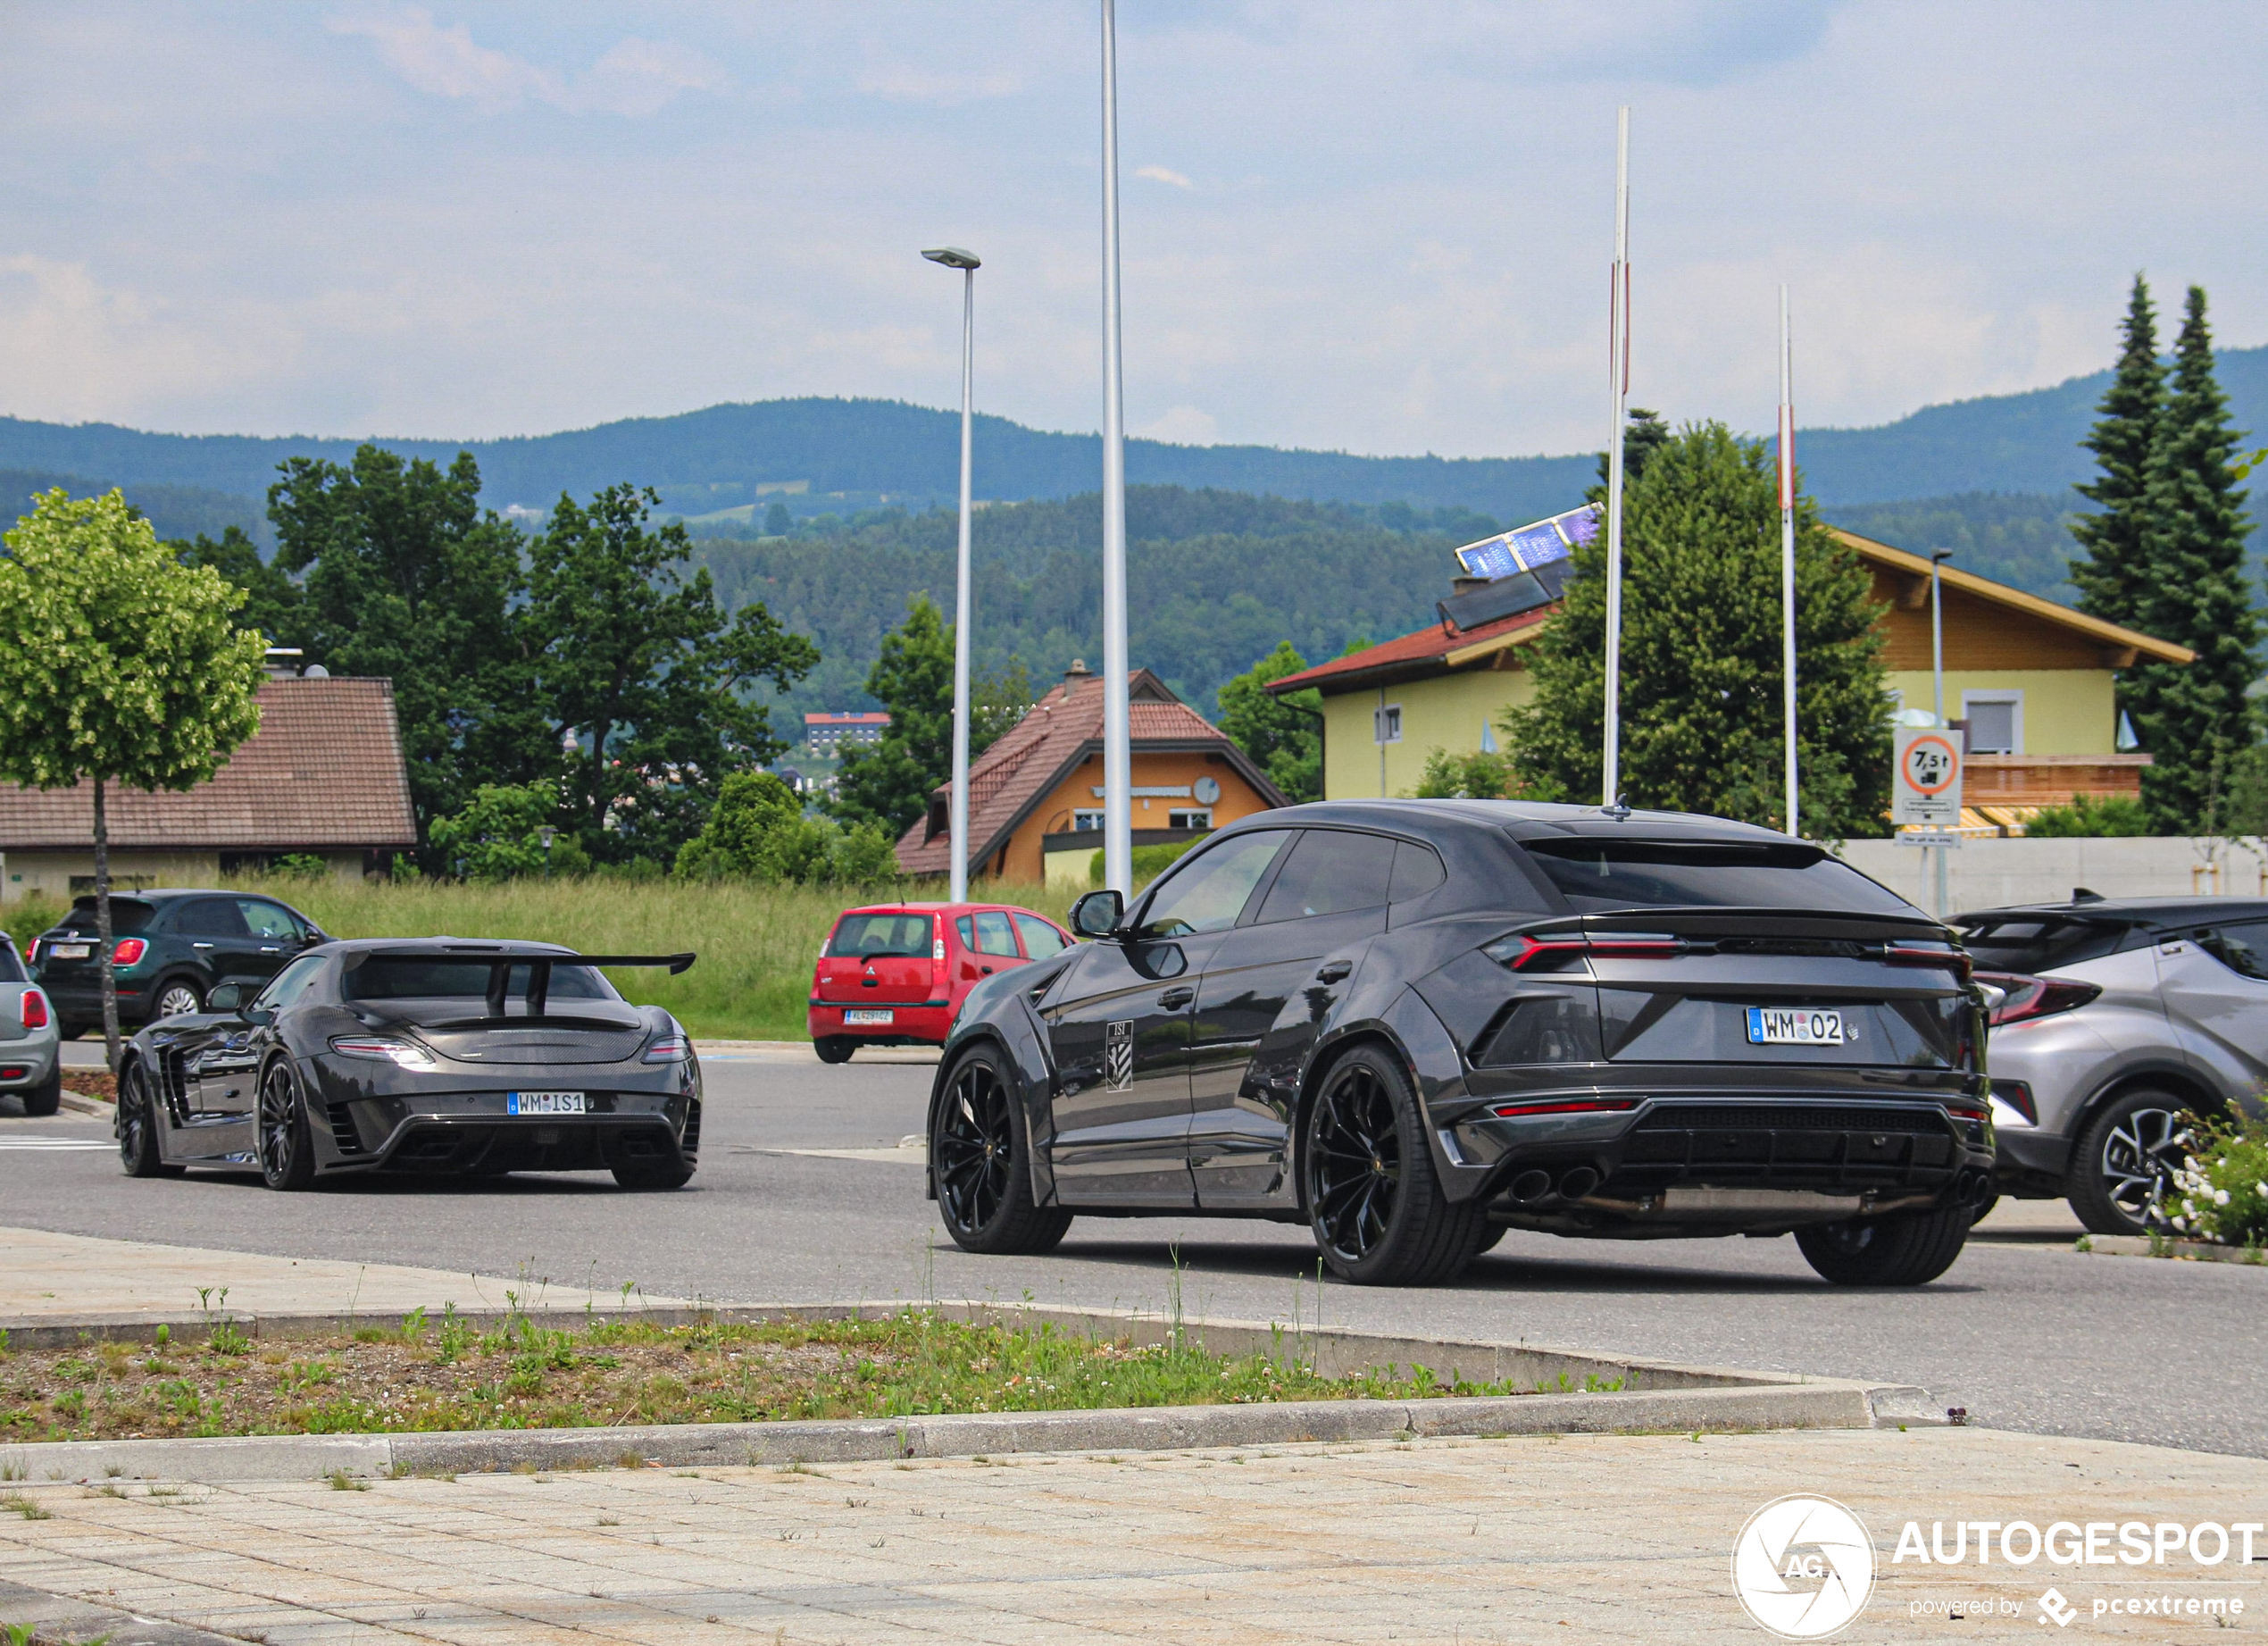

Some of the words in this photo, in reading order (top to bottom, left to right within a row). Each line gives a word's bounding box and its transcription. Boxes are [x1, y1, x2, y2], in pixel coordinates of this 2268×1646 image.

[1914, 750, 1939, 770] 7,5
[1941, 755, 1948, 767] t
[1753, 1027, 1760, 1036] D
[1764, 1012, 1796, 1038] WM
[519, 1094, 541, 1112] WM
[552, 1094, 583, 1112] IS1
